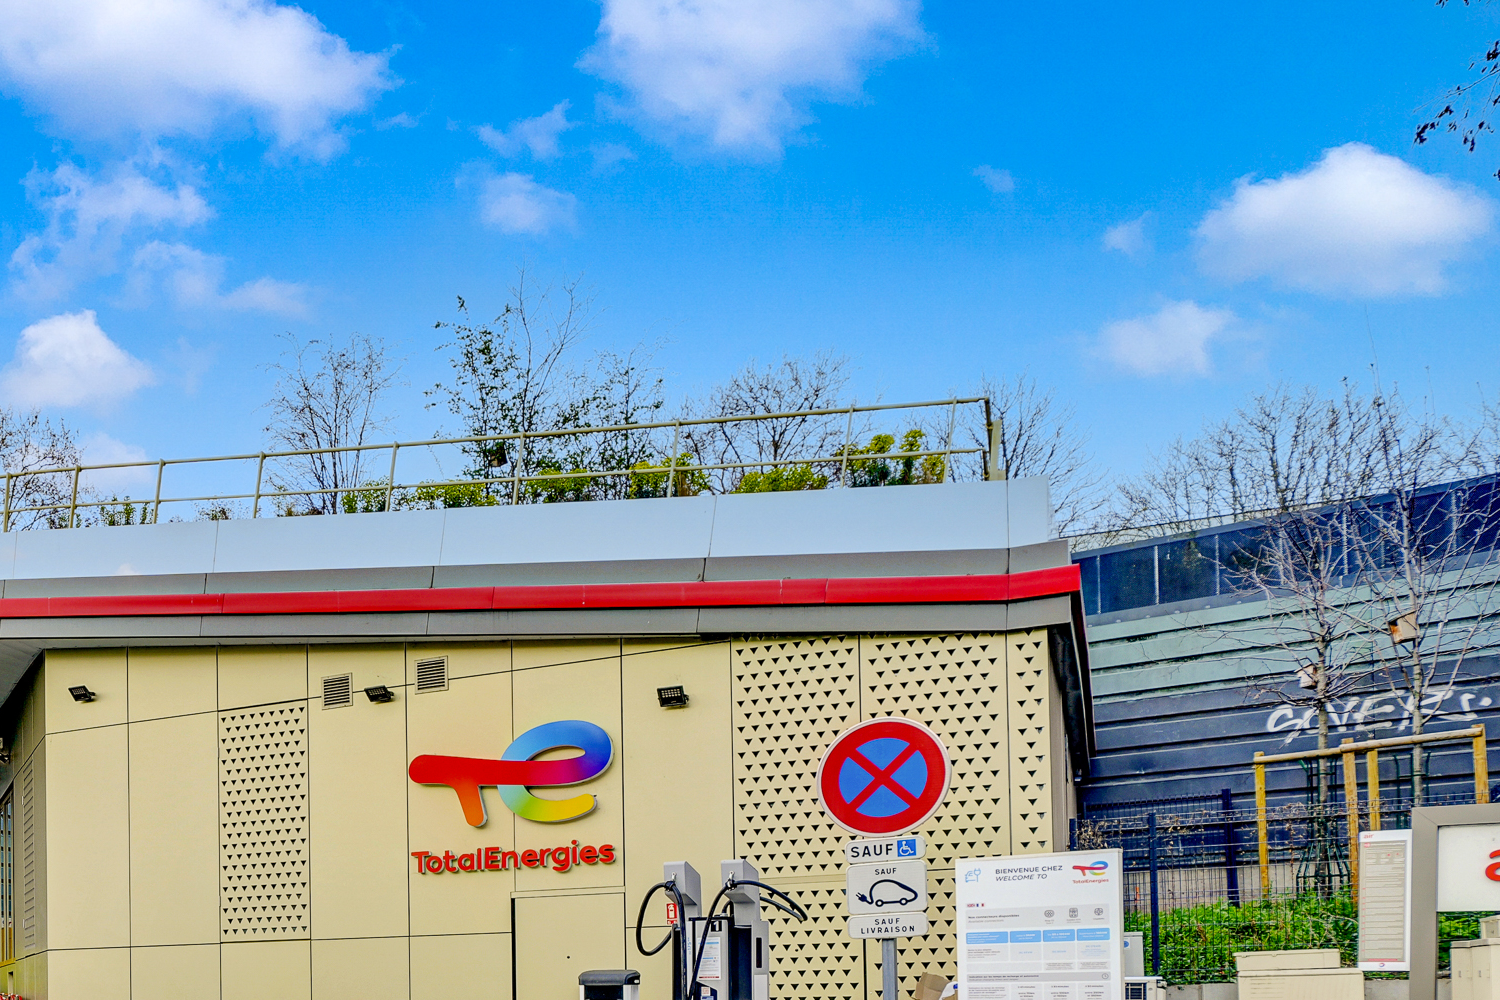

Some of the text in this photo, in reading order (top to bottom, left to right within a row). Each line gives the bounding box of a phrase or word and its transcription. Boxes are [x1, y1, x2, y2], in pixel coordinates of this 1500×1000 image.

[850, 843, 894, 858] SAUF
[411, 839, 616, 874] TotalEnergies
[874, 867, 897, 876] SAUF
[995, 866, 1039, 875] BIENVENUE
[995, 874, 1035, 882] WELCOME
[713, 921, 719, 932] 1
[874, 918, 900, 926] SAUF
[860, 925, 915, 935] LIVRAISON
